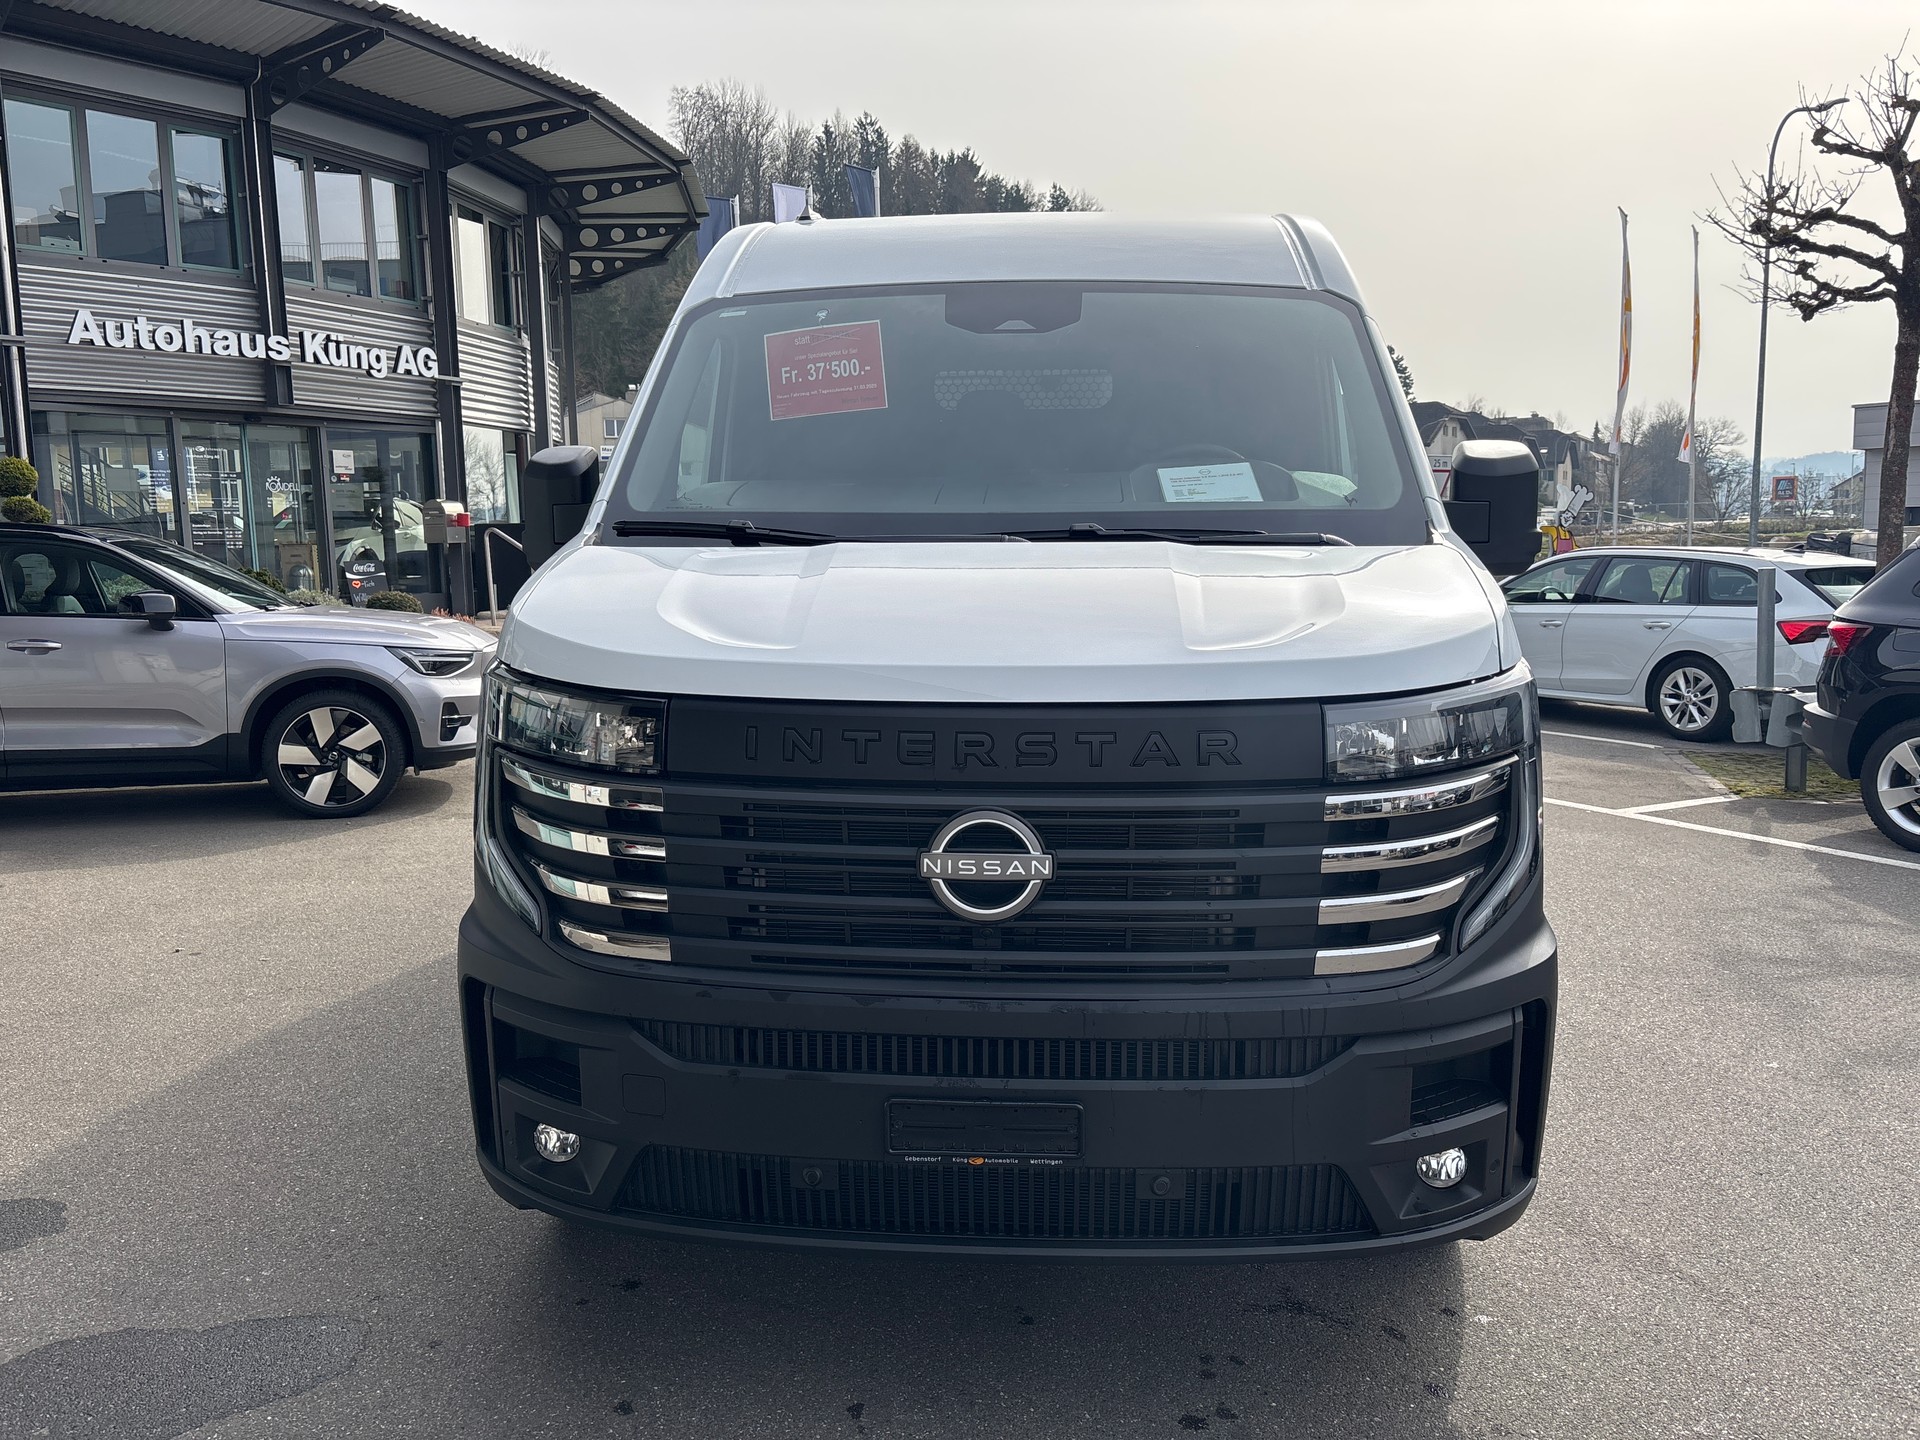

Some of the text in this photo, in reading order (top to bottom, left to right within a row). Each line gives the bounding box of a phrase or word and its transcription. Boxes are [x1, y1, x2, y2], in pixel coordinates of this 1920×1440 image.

[66, 308, 439, 378] Autohaus Küng AG
[794, 334, 811, 346] statt
[781, 366, 802, 385] Fr.
[1433, 459, 1441, 468] 25
[744, 725, 1243, 769] INTERSTAR
[922, 857, 1051, 876] NISSAN
[1029, 1158, 1064, 1166] Wettingen
